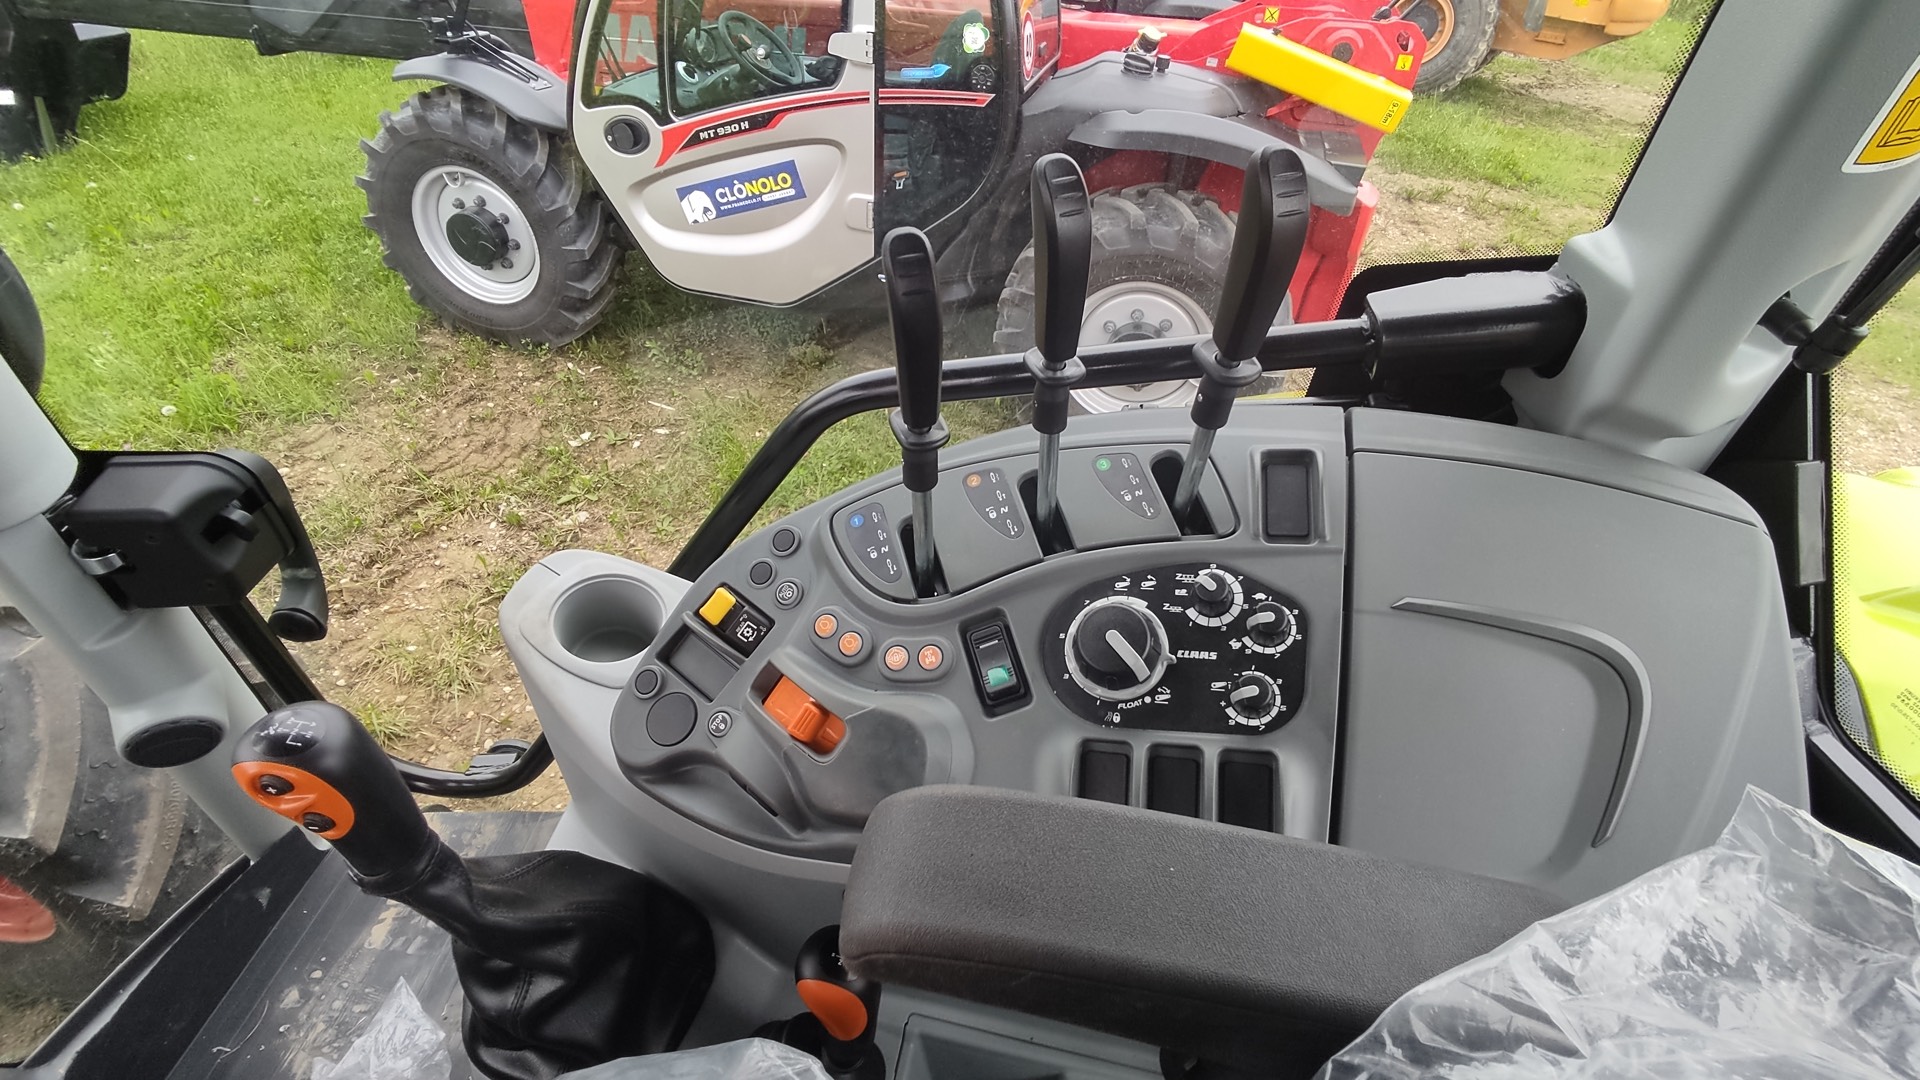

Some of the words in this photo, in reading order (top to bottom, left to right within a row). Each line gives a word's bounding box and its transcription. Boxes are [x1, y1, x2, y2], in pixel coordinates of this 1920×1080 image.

[699, 129, 716, 140] MT
[716, 123, 740, 136] 930
[740, 120, 750, 130] H
[715, 173, 792, 203] CLÒNOLO
[1177, 650, 1217, 660] CLAAS
[1117, 698, 1143, 709] FLOAT
[711, 714, 723, 730] STOP
